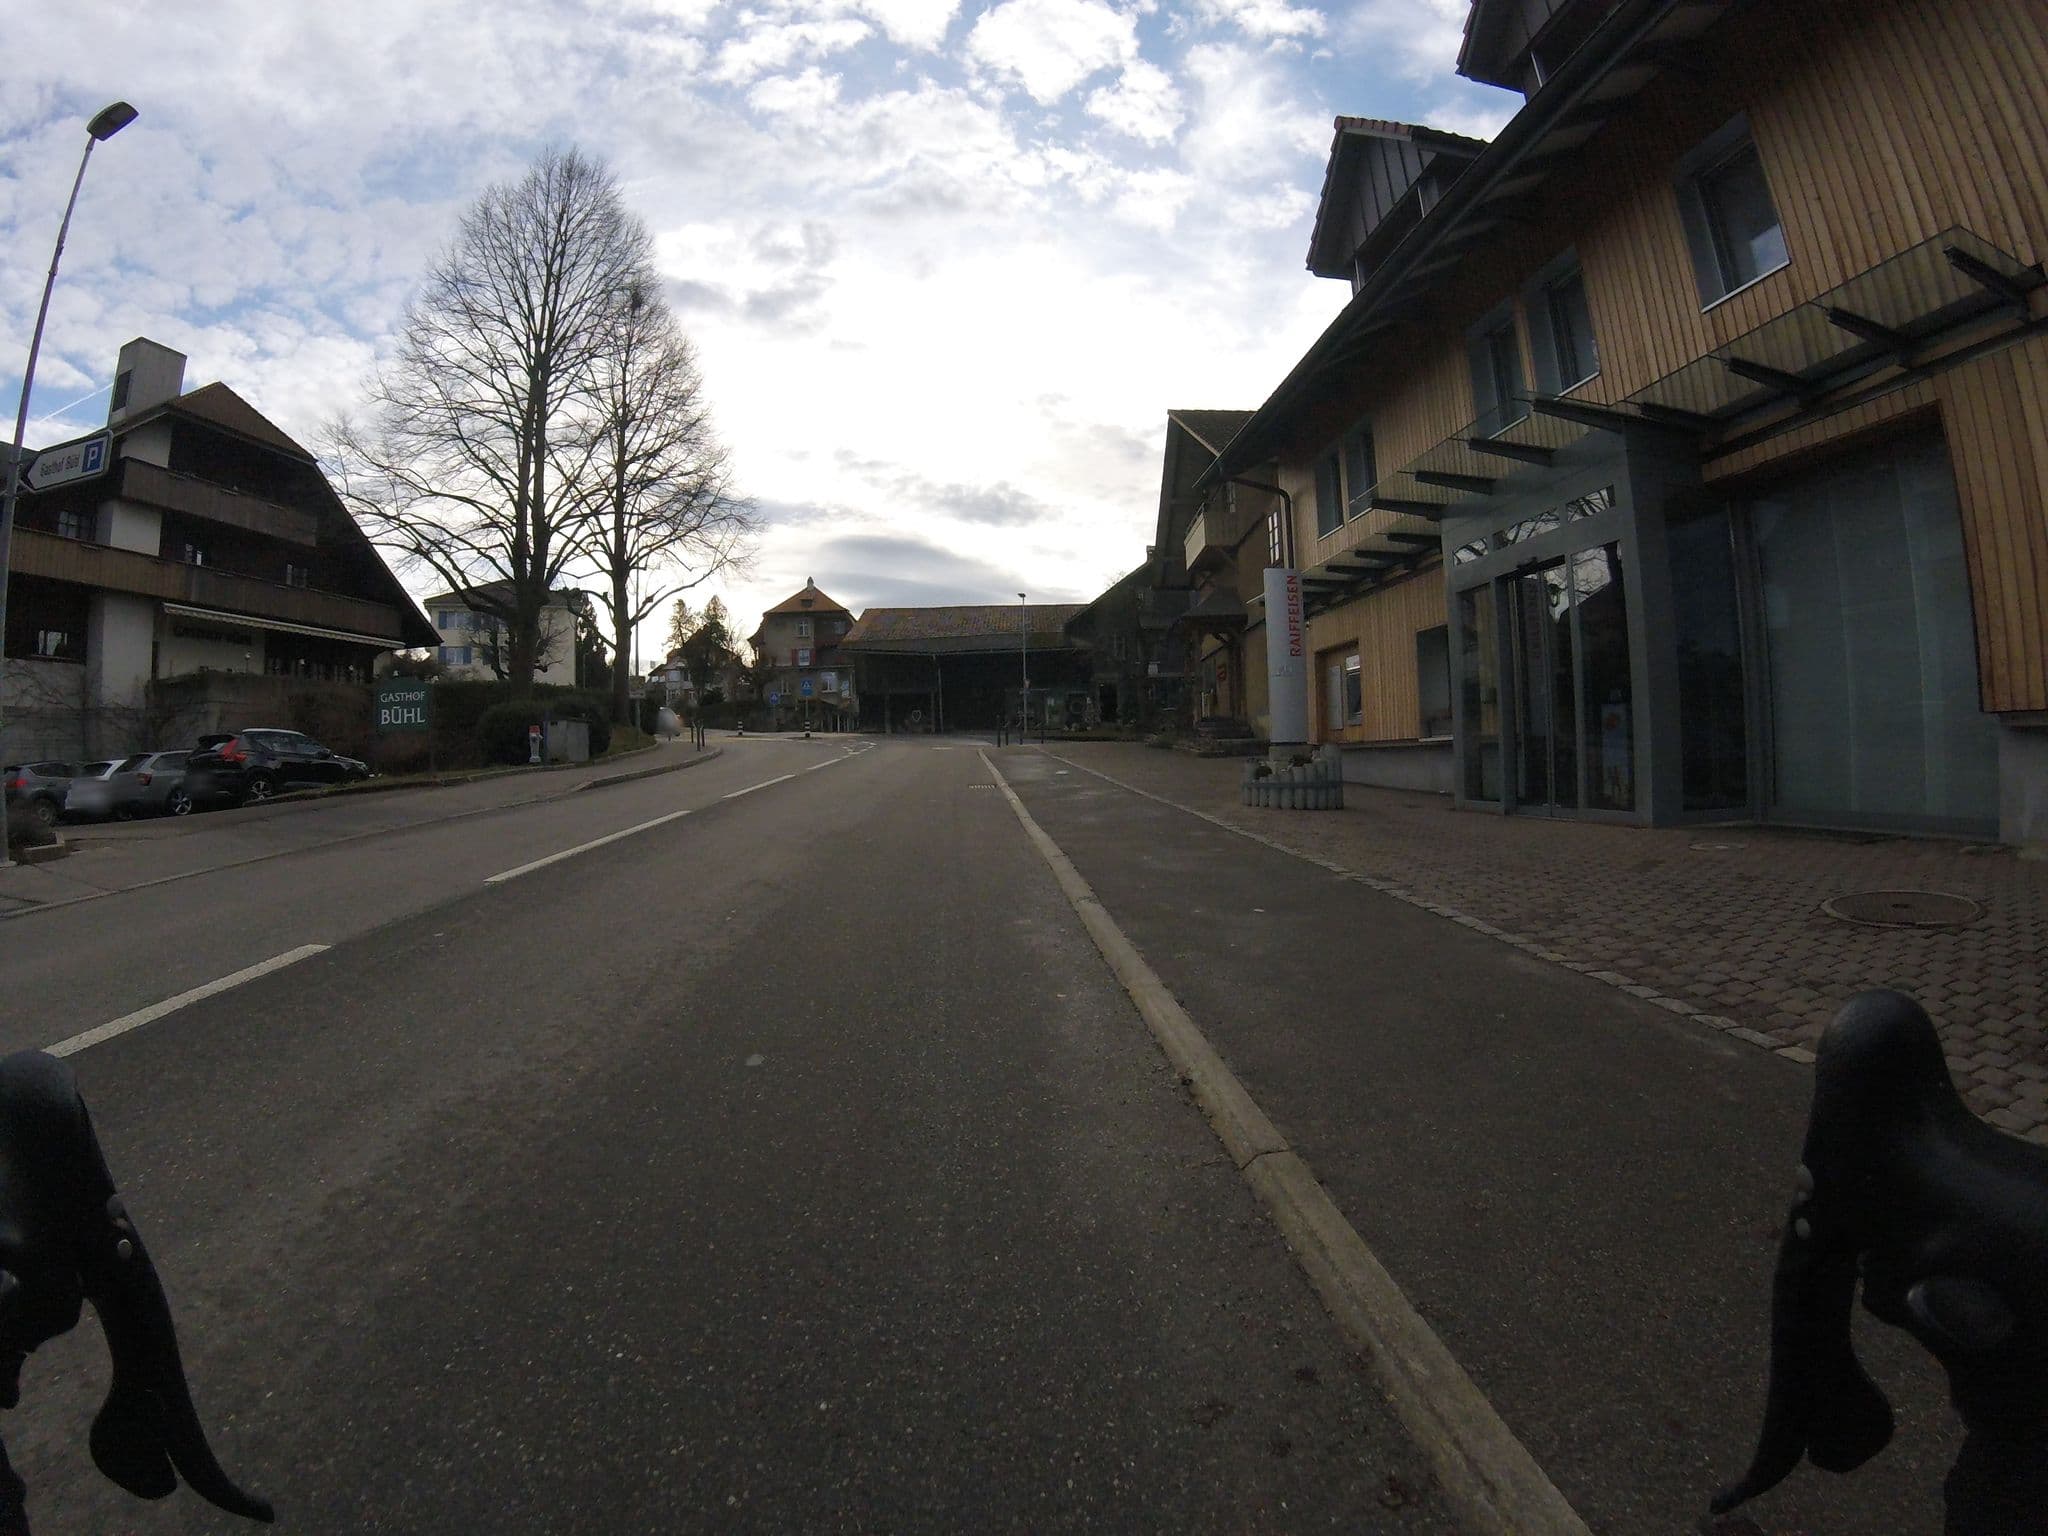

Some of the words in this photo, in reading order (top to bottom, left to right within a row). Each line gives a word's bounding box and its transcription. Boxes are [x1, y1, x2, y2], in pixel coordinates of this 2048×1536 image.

[1286, 576, 1301, 656] RAIFFEISEN
[380, 691, 425, 703] GASTHOF
[381, 706, 426, 725] BÜHL
